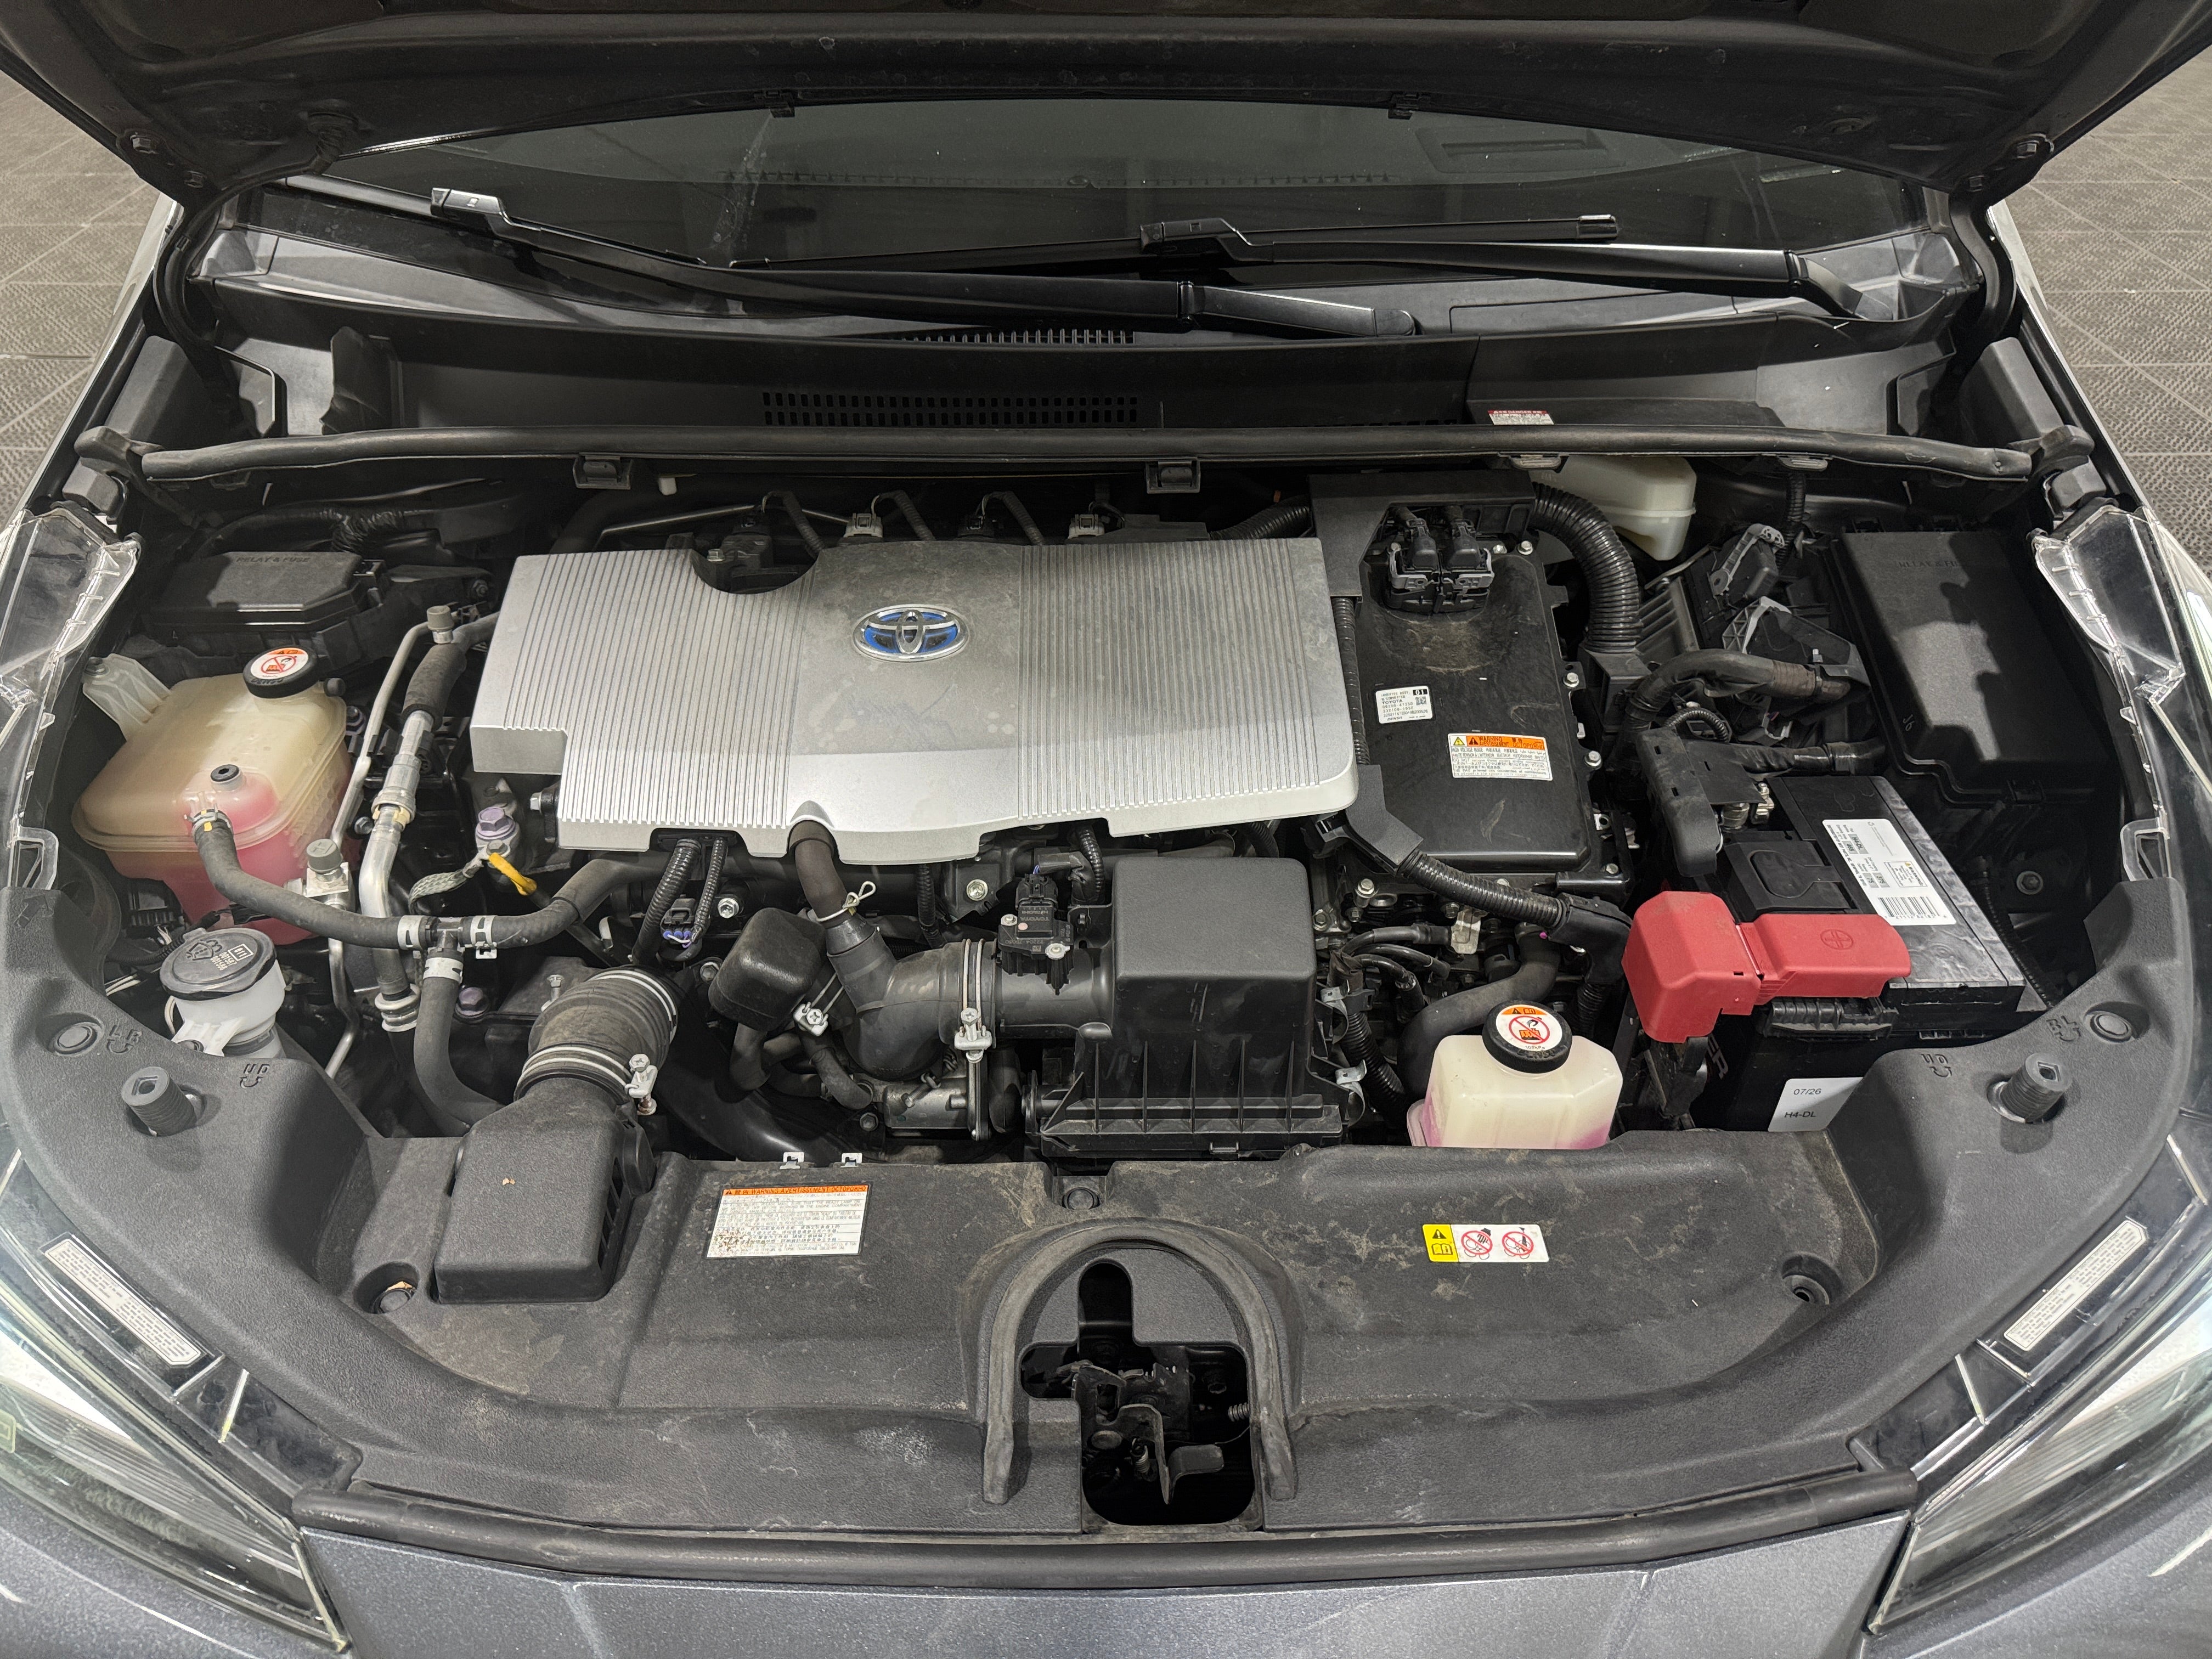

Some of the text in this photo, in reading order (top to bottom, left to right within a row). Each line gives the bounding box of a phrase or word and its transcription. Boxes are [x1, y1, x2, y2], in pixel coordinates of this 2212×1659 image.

[1876, 876, 1886, 884] 375
[1921, 1053, 1949, 1064] UP
[243, 1063, 270, 1075] UP
